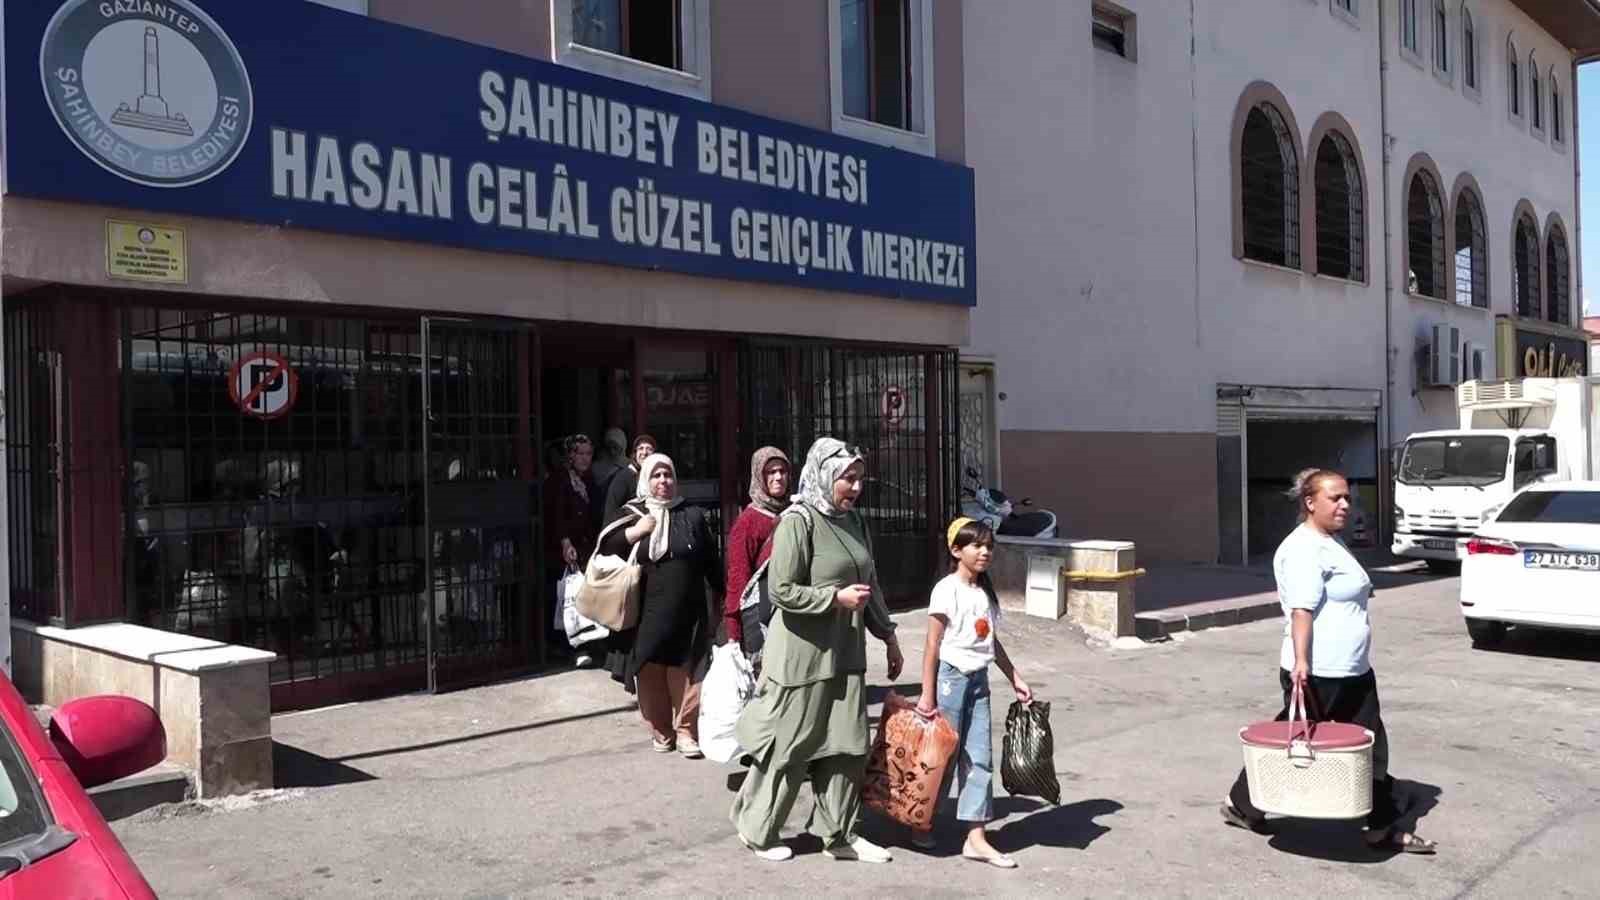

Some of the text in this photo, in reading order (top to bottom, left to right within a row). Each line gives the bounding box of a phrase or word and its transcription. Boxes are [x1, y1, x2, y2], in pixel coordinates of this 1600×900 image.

[271, 128, 966, 288] HASAN CELÂL GÜZEL GENÇLİK MERKEZİ
[480, 70, 868, 205] ŞAHİNBEY BELEDİYESİ
